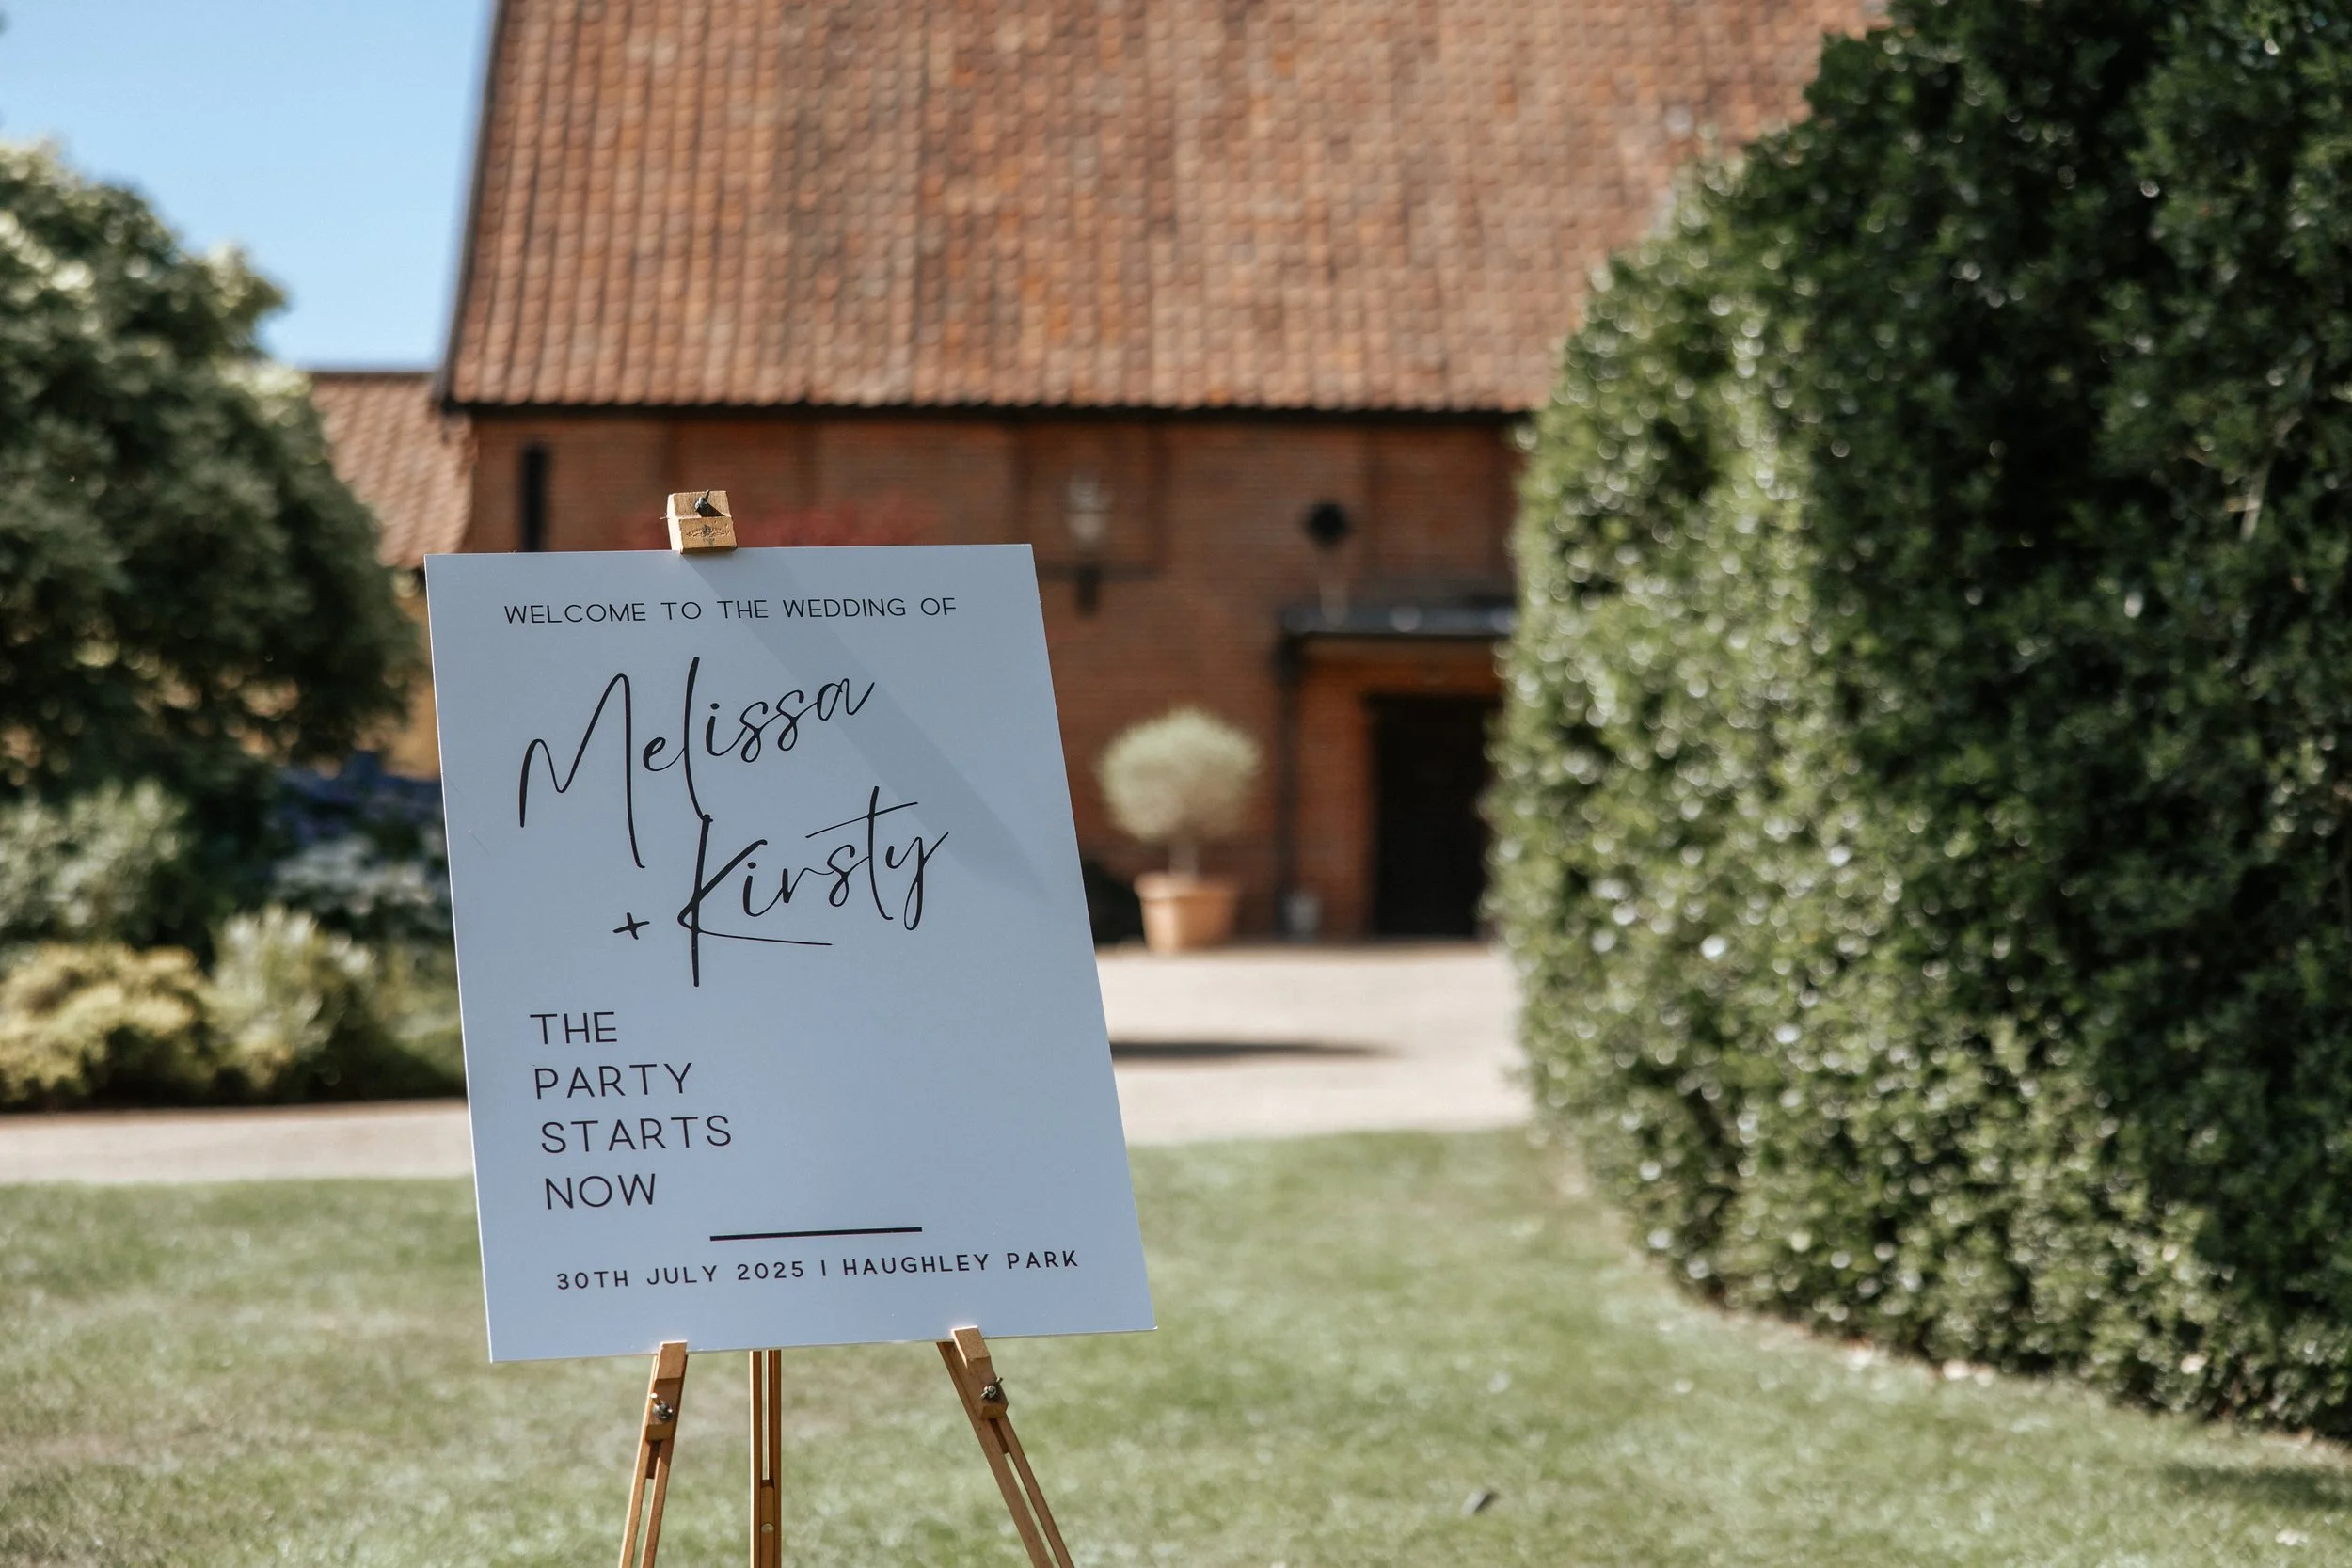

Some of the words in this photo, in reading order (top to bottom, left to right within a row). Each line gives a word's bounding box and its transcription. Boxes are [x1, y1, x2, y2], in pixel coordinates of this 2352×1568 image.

[503, 598, 647, 625] WELCOME
[660, 600, 702, 621] TO
[716, 599, 769, 620] THE
[782, 597, 907, 618] WEDDING
[920, 597, 957, 617] OF
[518, 656, 876, 869] Melissa
[676, 785, 949, 988] Kirsty
[529, 1010, 618, 1045] THE
[533, 1062, 693, 1100] PARTY
[541, 1114, 732, 1154] STARTS
[545, 1172, 656, 1211] NOW
[556, 1269, 629, 1291] 30TH
[646, 1264, 718, 1286] JULY
[737, 1260, 804, 1281] 2025
[842, 1253, 990, 1276] HAUGHLEY
[1006, 1249, 1079, 1270] PARK
